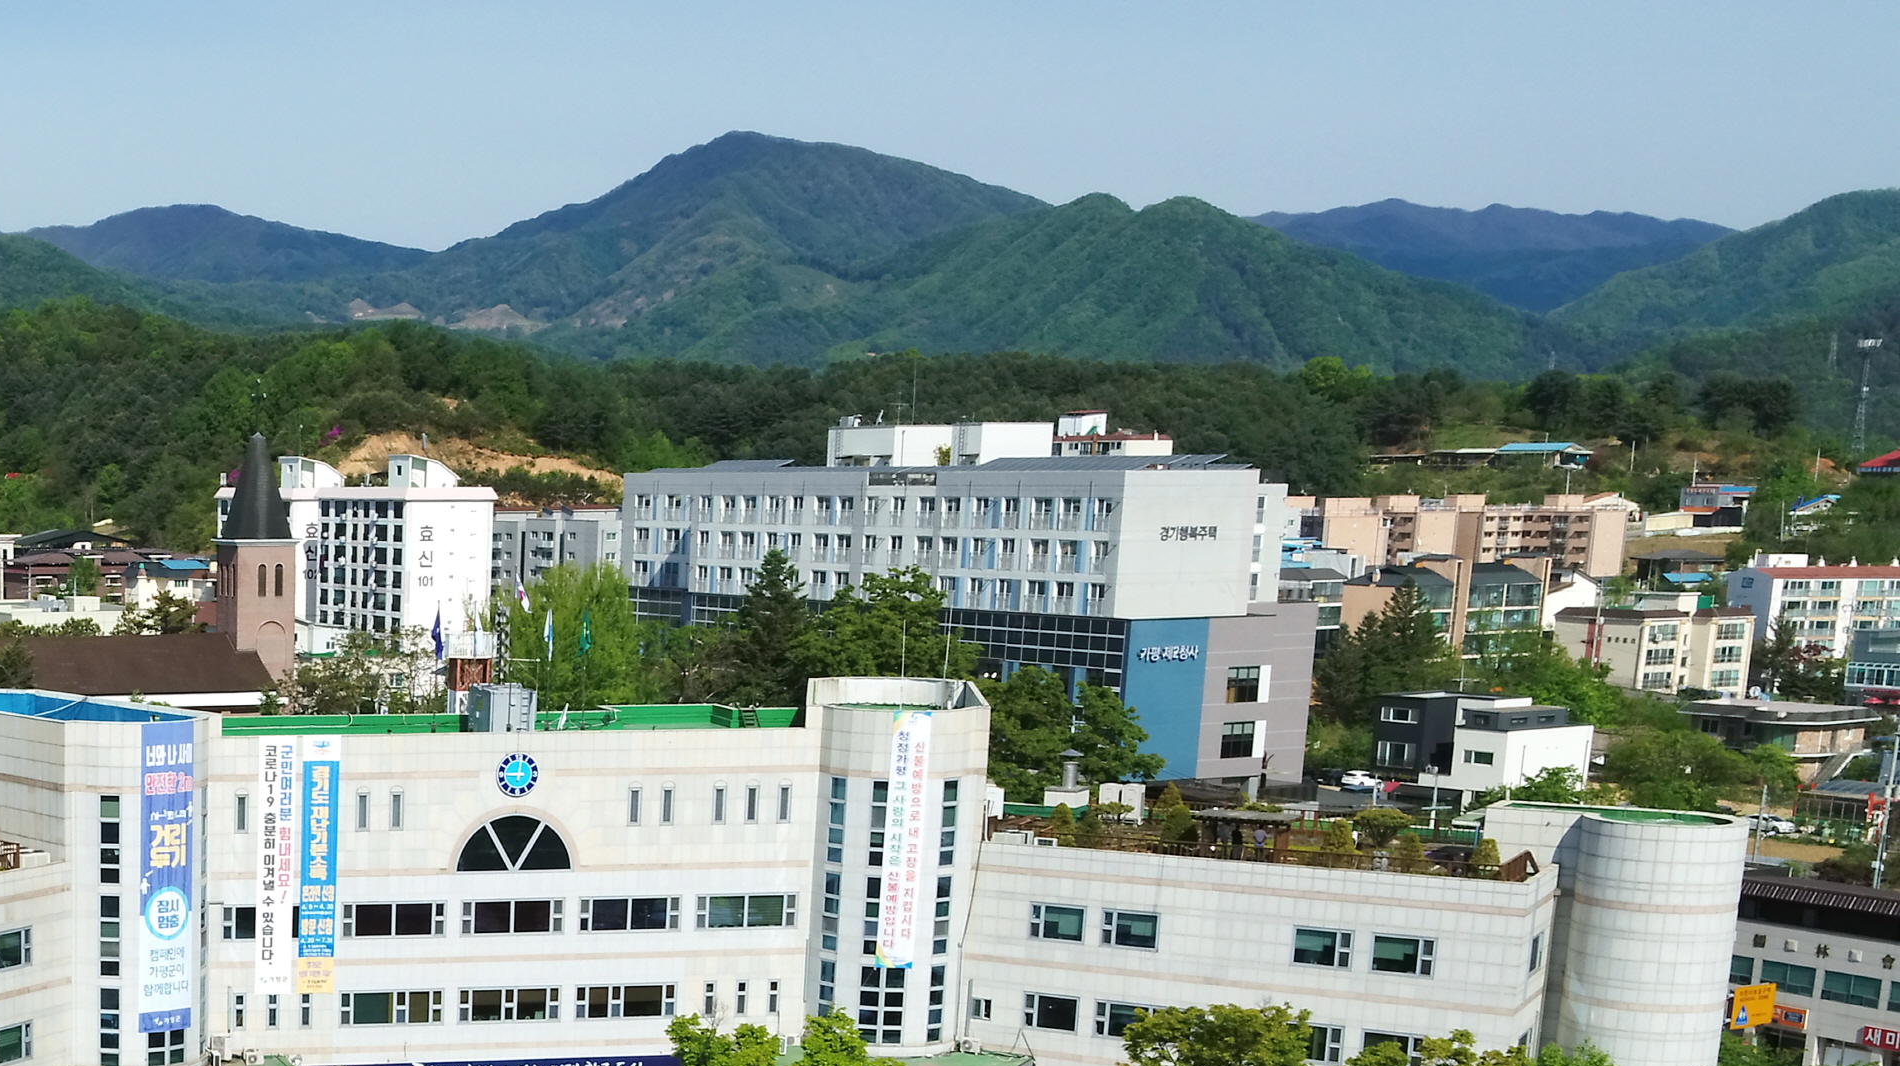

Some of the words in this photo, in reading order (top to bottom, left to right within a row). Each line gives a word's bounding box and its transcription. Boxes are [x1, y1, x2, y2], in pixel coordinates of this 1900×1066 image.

[1160, 526, 1217, 541] 경기행복주택
[418, 525, 434, 568] 효신
[417, 575, 434, 587] 101
[1140, 647, 1160, 661] 가평
[1162, 644, 1199, 660] 제2청사
[146, 745, 166, 767] 너와
[167, 744, 177, 765] 나
[896, 731, 909, 776] 청정가평
[145, 771, 177, 795] 안전한
[177, 771, 193, 792] 2m
[265, 745, 277, 807] 코로나19
[280, 745, 293, 821] 군민여러분
[894, 781, 907, 790] 그
[910, 741, 925, 821] 산불예방으로
[151, 823, 186, 847] 거리
[264, 812, 276, 849] 충분히
[909, 828, 919, 838] 내
[150, 845, 186, 868] 두기
[889, 833, 901, 865] 시작은
[263, 854, 275, 891] 이겨낼
[906, 844, 918, 882] 고장을
[157, 899, 179, 913] 잠시
[262, 896, 274, 907] 수
[882, 871, 899, 948] 산불예방입니다
[158, 914, 179, 929] 멈춤
[262, 912, 274, 965] 있습니다.
[150, 947, 185, 962] 캠페인에
[149, 964, 185, 979] 가평군이
[143, 980, 189, 996] 함께합니다
[164, 1015, 181, 1024] 가평군
